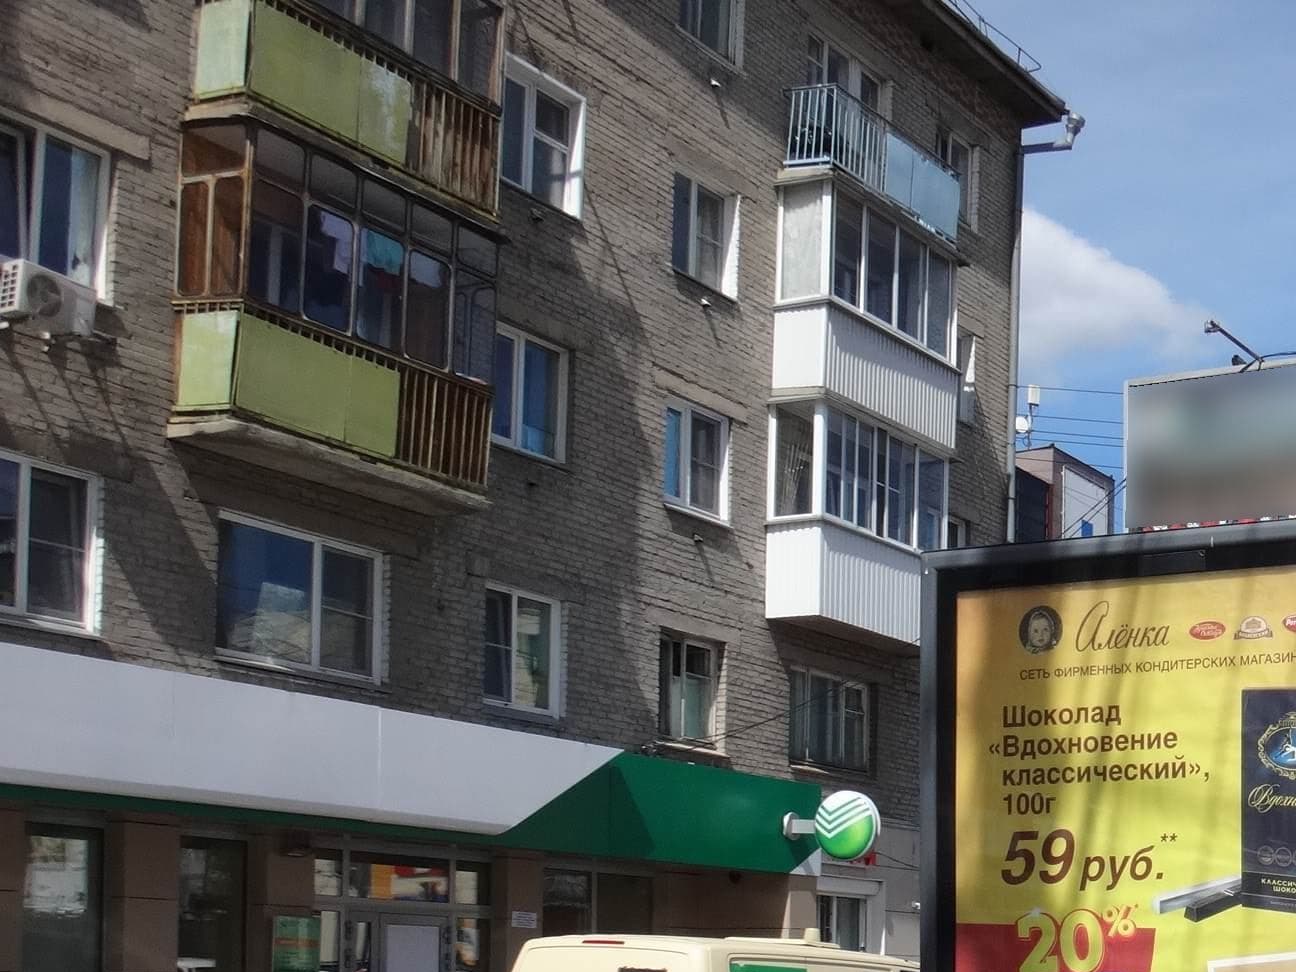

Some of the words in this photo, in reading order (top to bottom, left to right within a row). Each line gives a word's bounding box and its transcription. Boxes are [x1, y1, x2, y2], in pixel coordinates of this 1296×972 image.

[1076, 600, 1169, 651] Алёнка
[1020, 669, 1050, 681] СЕТЬ
[1054, 662, 1132, 678] ФИРМЕННЫХ
[1135, 656, 1236, 674] КОНДИТЕРСКИХ
[1002, 705, 1122, 728] Шоколад
[988, 731, 1178, 760] «Вдохновение
[1002, 755, 1210, 786] классический»,
[1003, 793, 1056, 815] 100г
[1001, 828, 1076, 886] 59
